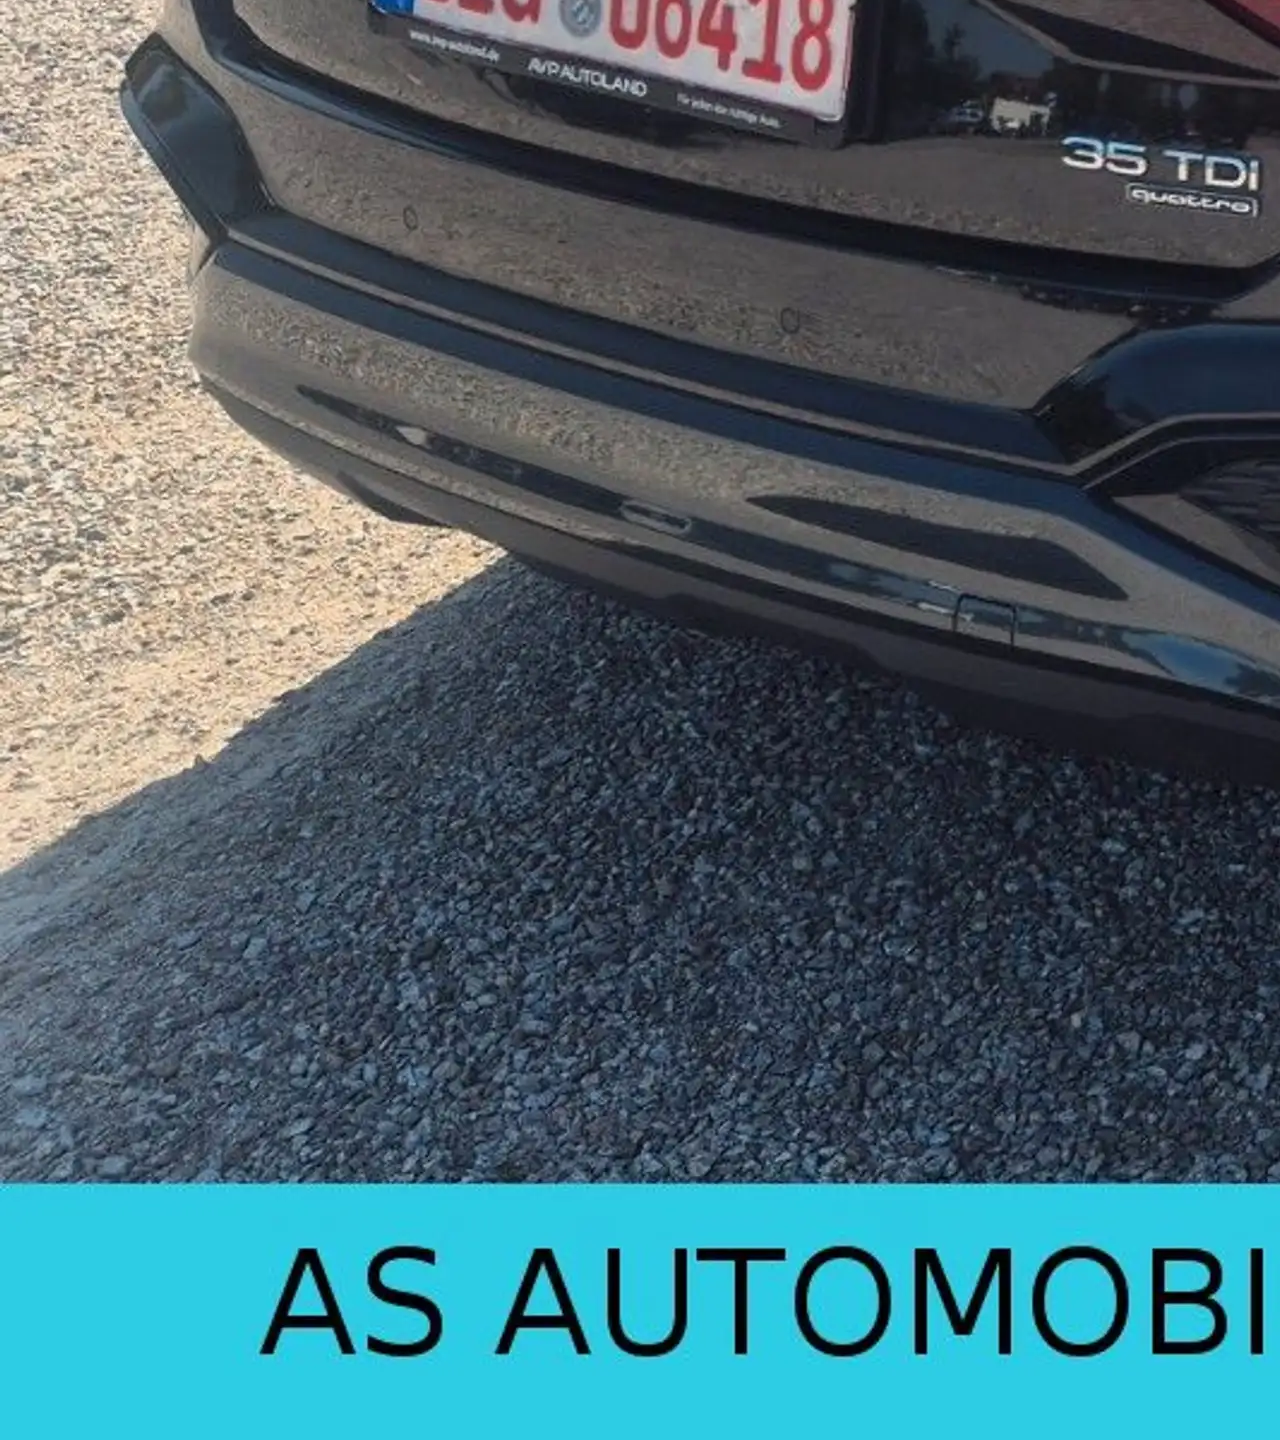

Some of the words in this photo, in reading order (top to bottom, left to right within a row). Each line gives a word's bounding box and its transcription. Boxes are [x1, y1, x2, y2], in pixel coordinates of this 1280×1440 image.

[560, 64, 648, 98] AUTOLAND
[1060, 135, 1149, 177] 35
[1162, 148, 1260, 192] TDI
[1130, 187, 1253, 215] quattro
